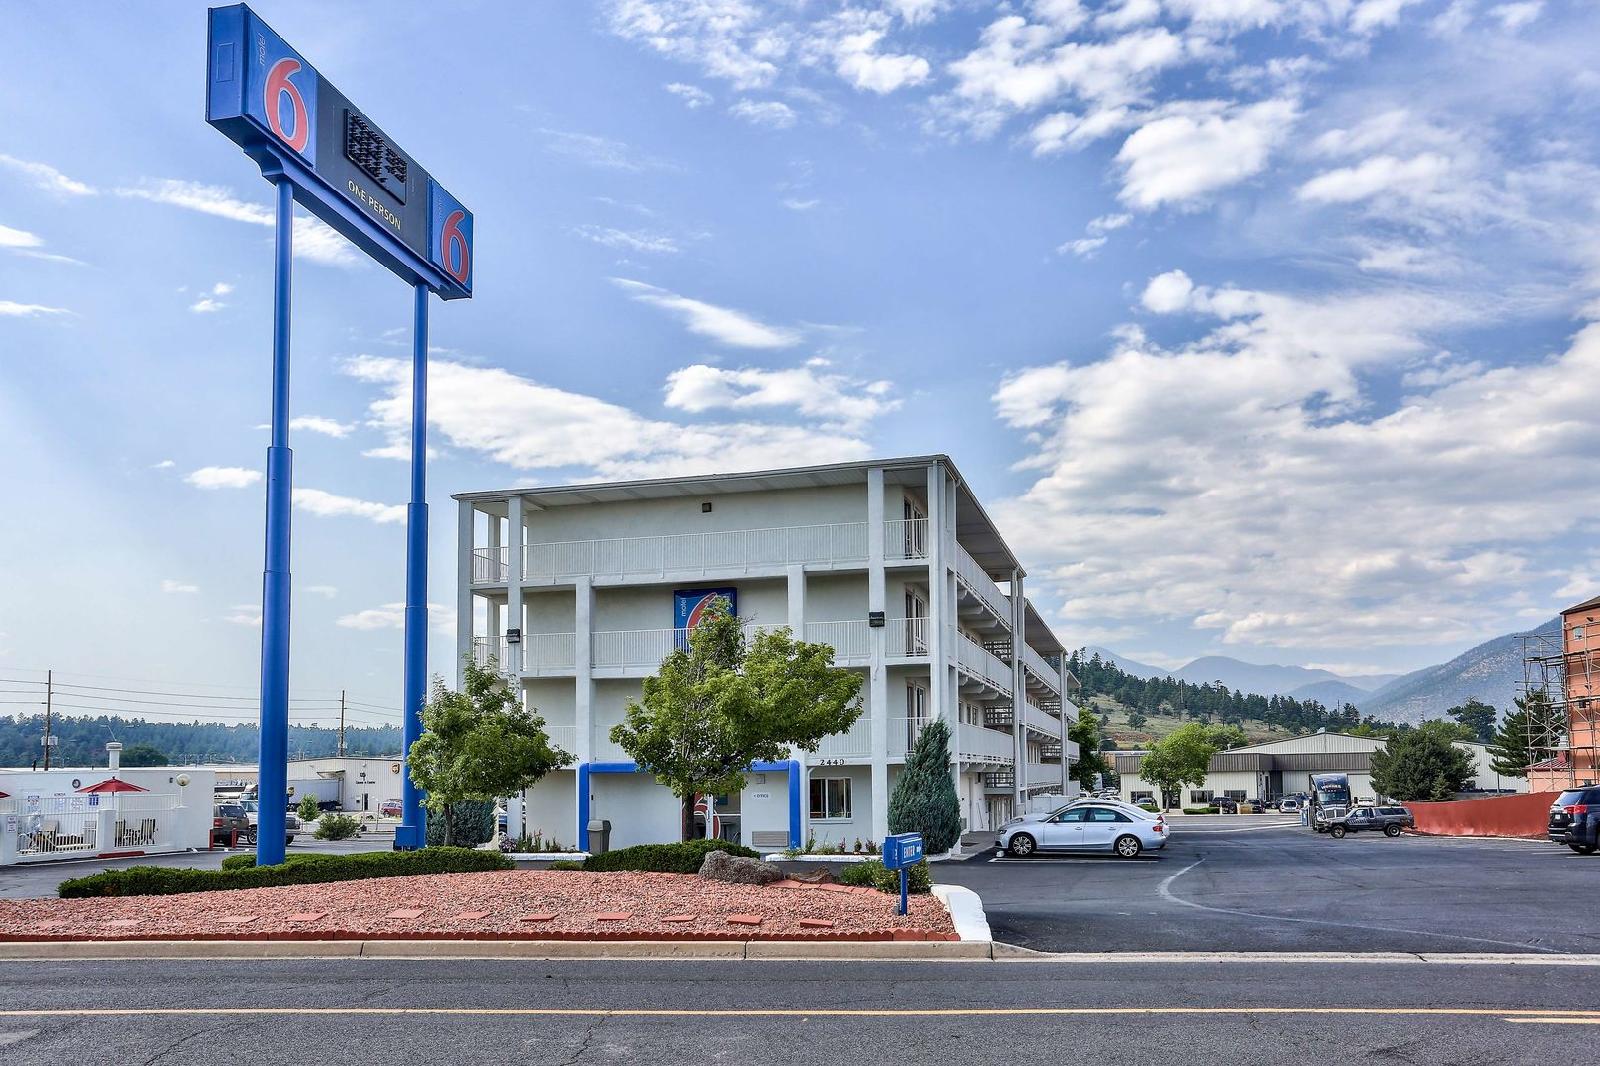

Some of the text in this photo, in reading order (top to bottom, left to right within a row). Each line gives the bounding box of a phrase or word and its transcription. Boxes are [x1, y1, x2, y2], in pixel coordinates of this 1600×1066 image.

[258, 33, 309, 154] motel 6
[348, 180, 401, 230] ONE PERSON
[441, 210, 469, 284] 6
